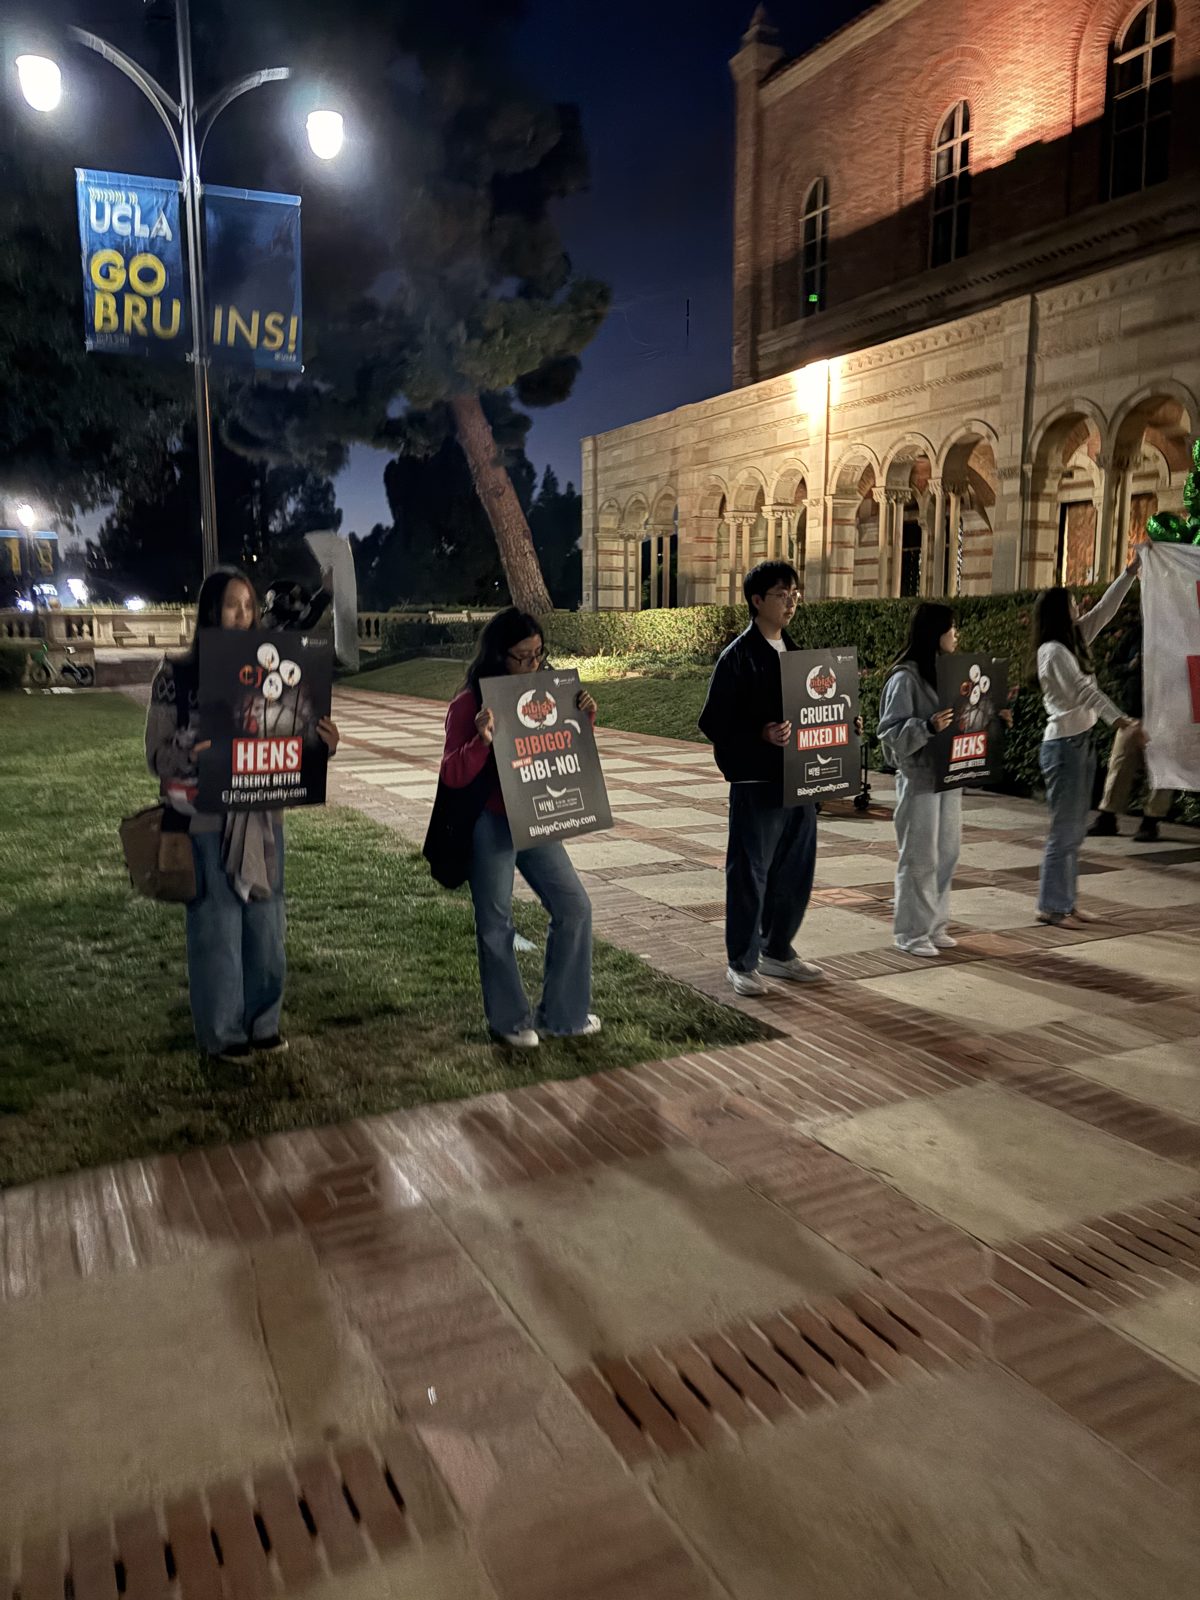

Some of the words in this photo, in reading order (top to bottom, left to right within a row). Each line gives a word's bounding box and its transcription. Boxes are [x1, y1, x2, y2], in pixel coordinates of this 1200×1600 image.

[90, 200, 172, 241] UCLA
[90, 248, 167, 297] GO
[93, 290, 182, 340] BRU
[212, 304, 299, 354] INS!
[239, 664, 264, 688] CJ
[800, 703, 845, 725] CRUELTY
[514, 730, 573, 758] BIBIGO?
[799, 729, 833, 748] MIXED
[835, 726, 848, 743] IN
[952, 733, 985, 760] HENS
[236, 740, 299, 772] HENS
[519, 754, 581, 783] BIBI-NO!
[231, 773, 271, 788] DESERVE
[273, 771, 301, 787] BETTER
[529, 813, 597, 838] BibigoCruelty.com
